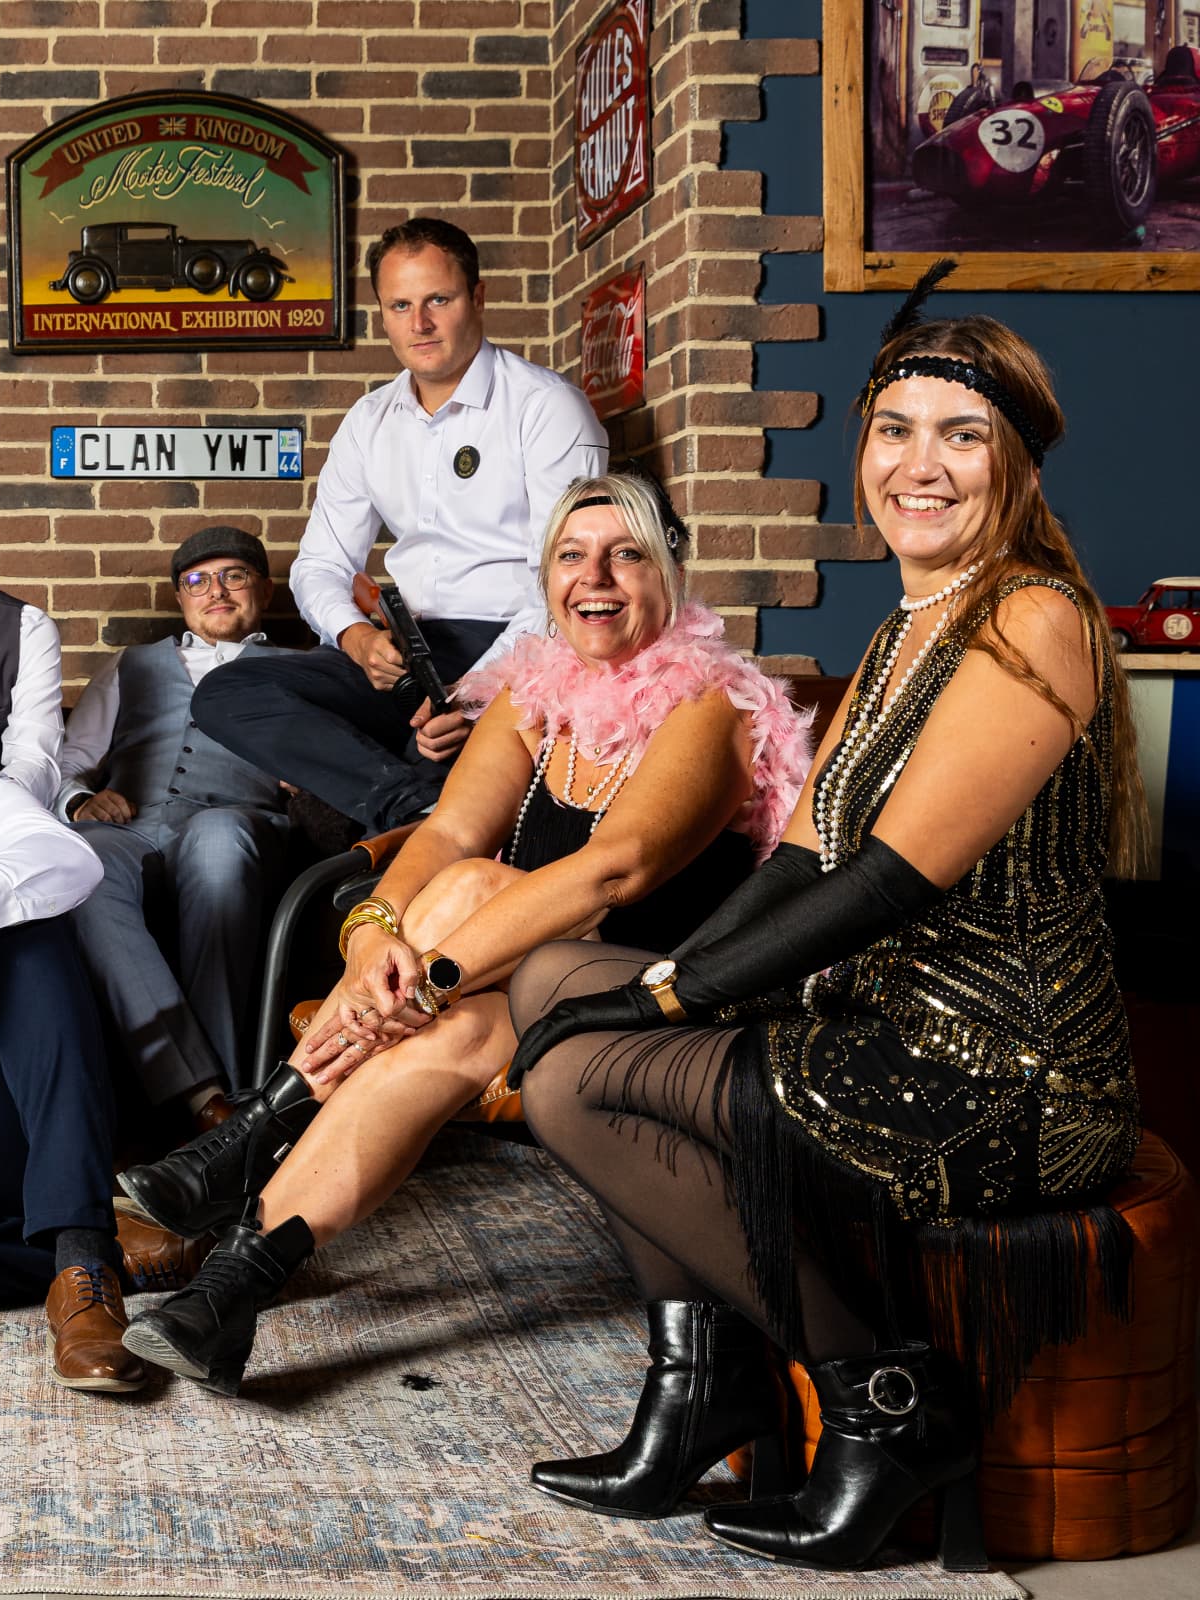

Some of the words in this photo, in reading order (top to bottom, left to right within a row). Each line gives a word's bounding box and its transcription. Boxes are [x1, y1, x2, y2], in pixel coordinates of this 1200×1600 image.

[581, 28, 633, 132] HUILES
[61, 120, 142, 166] UNITED
[194, 117, 288, 161] KINGDOM
[579, 95, 636, 200] RENAULT
[989, 117, 1038, 150] 32
[79, 146, 178, 210] Motor
[152, 145, 266, 209] Festival
[32, 311, 179, 333] INTERNATIONAL
[181, 309, 282, 330] EXHIBITION
[287, 308, 325, 327] 1920
[59, 458, 69, 470] F
[79, 433, 177, 472] CLAN
[202, 434, 274, 472] YWT
[279, 455, 299, 473] 44
[1166, 618, 1188, 636] 54
